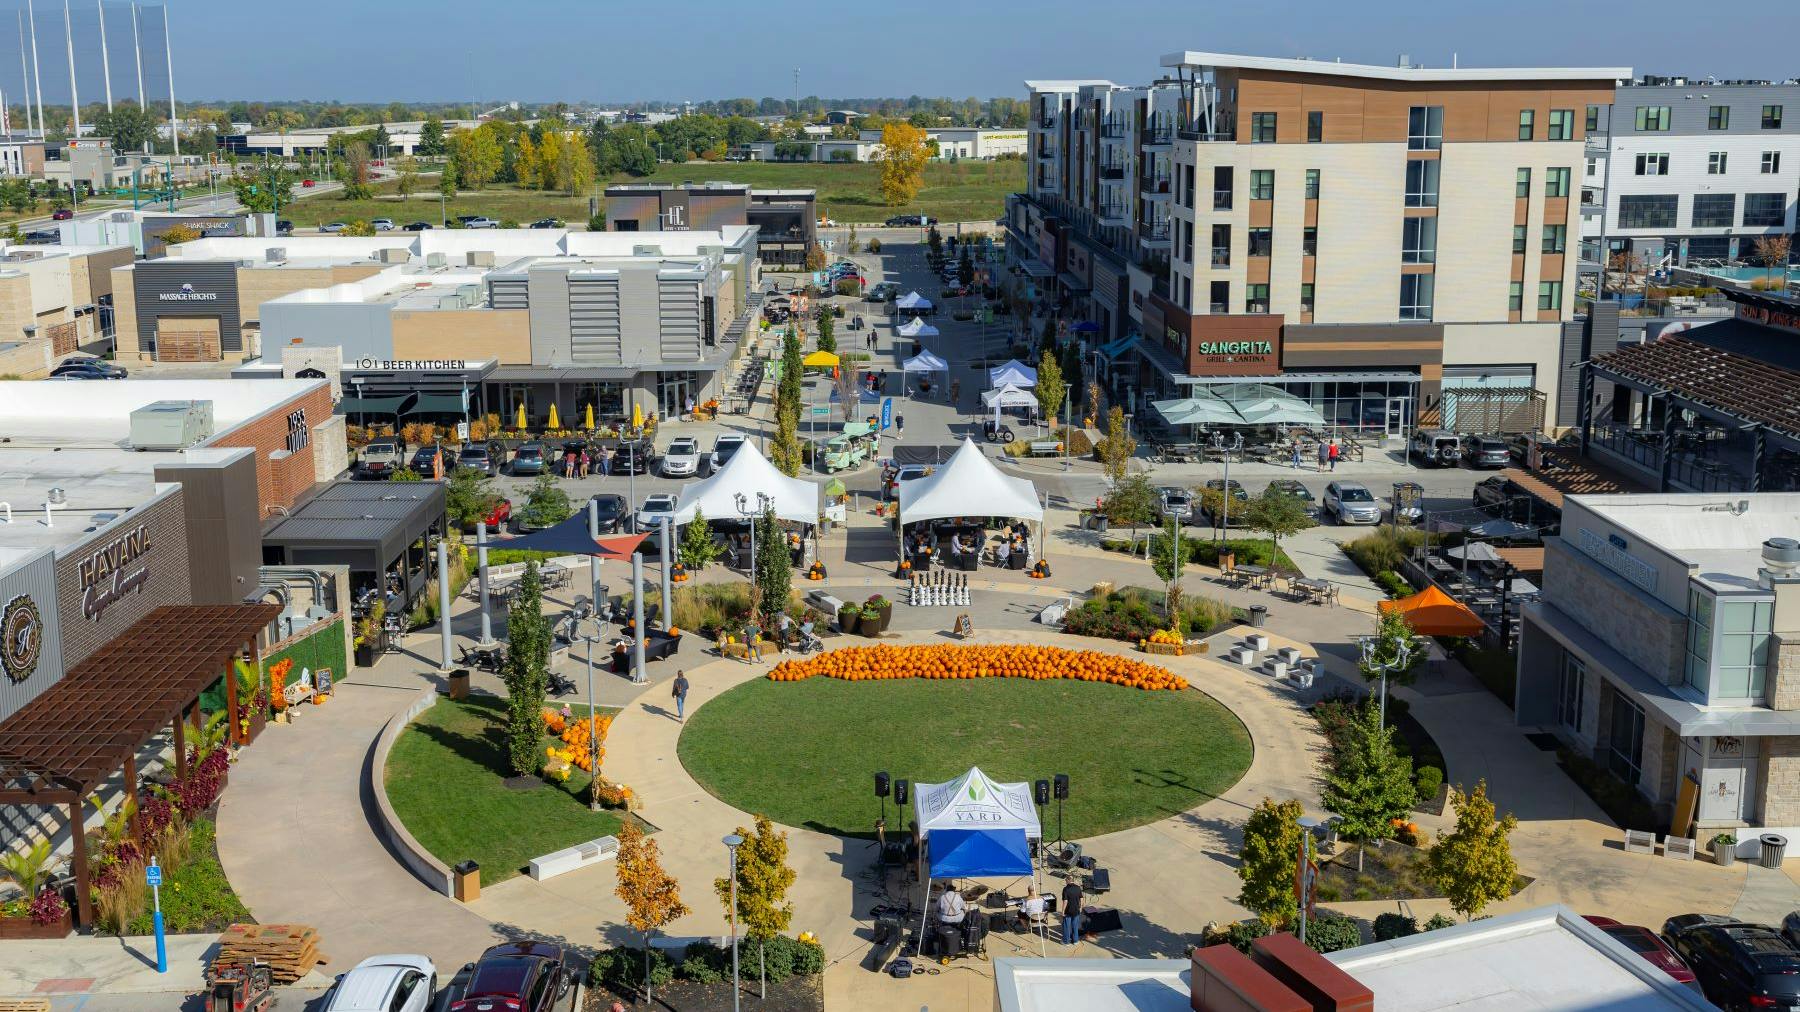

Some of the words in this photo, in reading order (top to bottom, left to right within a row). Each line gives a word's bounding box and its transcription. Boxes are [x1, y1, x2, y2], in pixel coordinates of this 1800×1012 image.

[1200, 341, 1273, 355] SANGRITA
[383, 360, 413, 370] BEER
[415, 359, 465, 370] KITCHEN
[1233, 355, 1266, 363] CANTINA
[78, 525, 151, 592] HAVANA
[955, 812, 1002, 821] YARD
